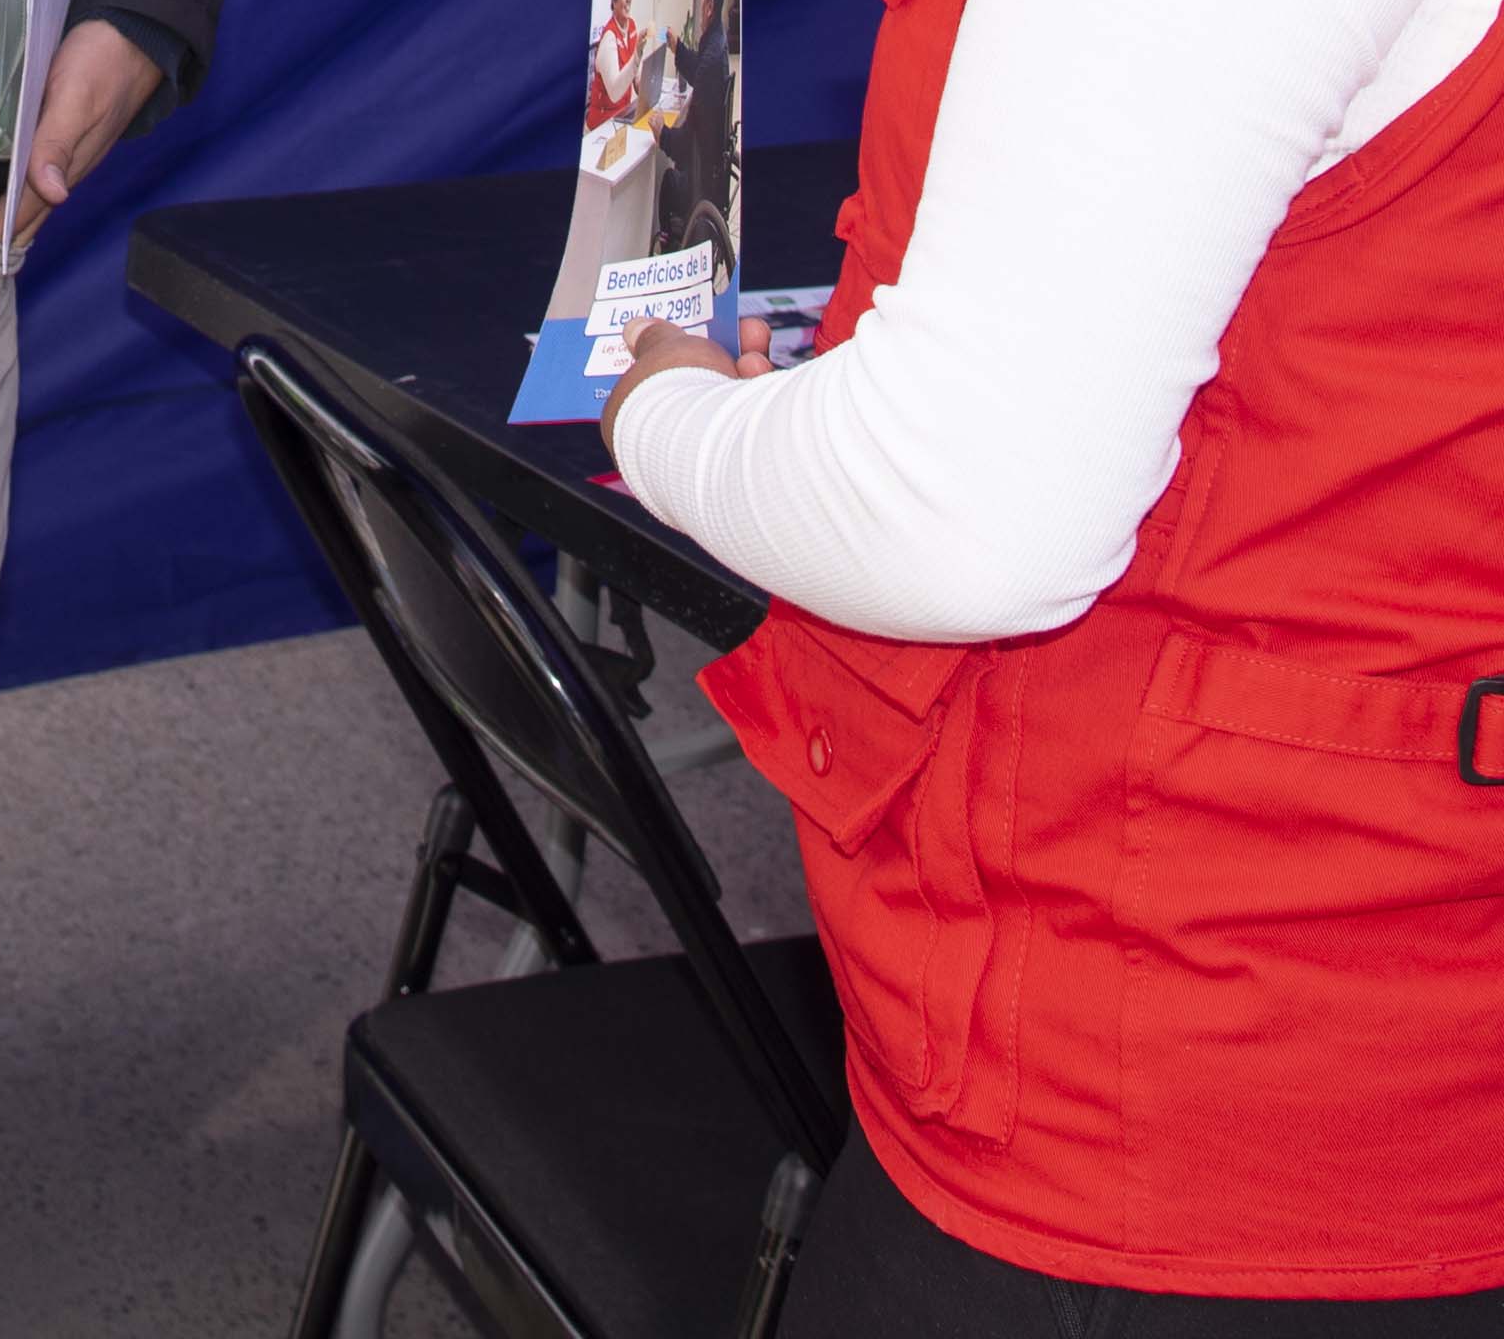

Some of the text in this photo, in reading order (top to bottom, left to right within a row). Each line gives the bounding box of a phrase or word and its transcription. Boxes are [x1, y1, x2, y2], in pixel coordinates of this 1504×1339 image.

[607, 250, 708, 291] Beneficios de la
[666, 293, 702, 322] 29973
